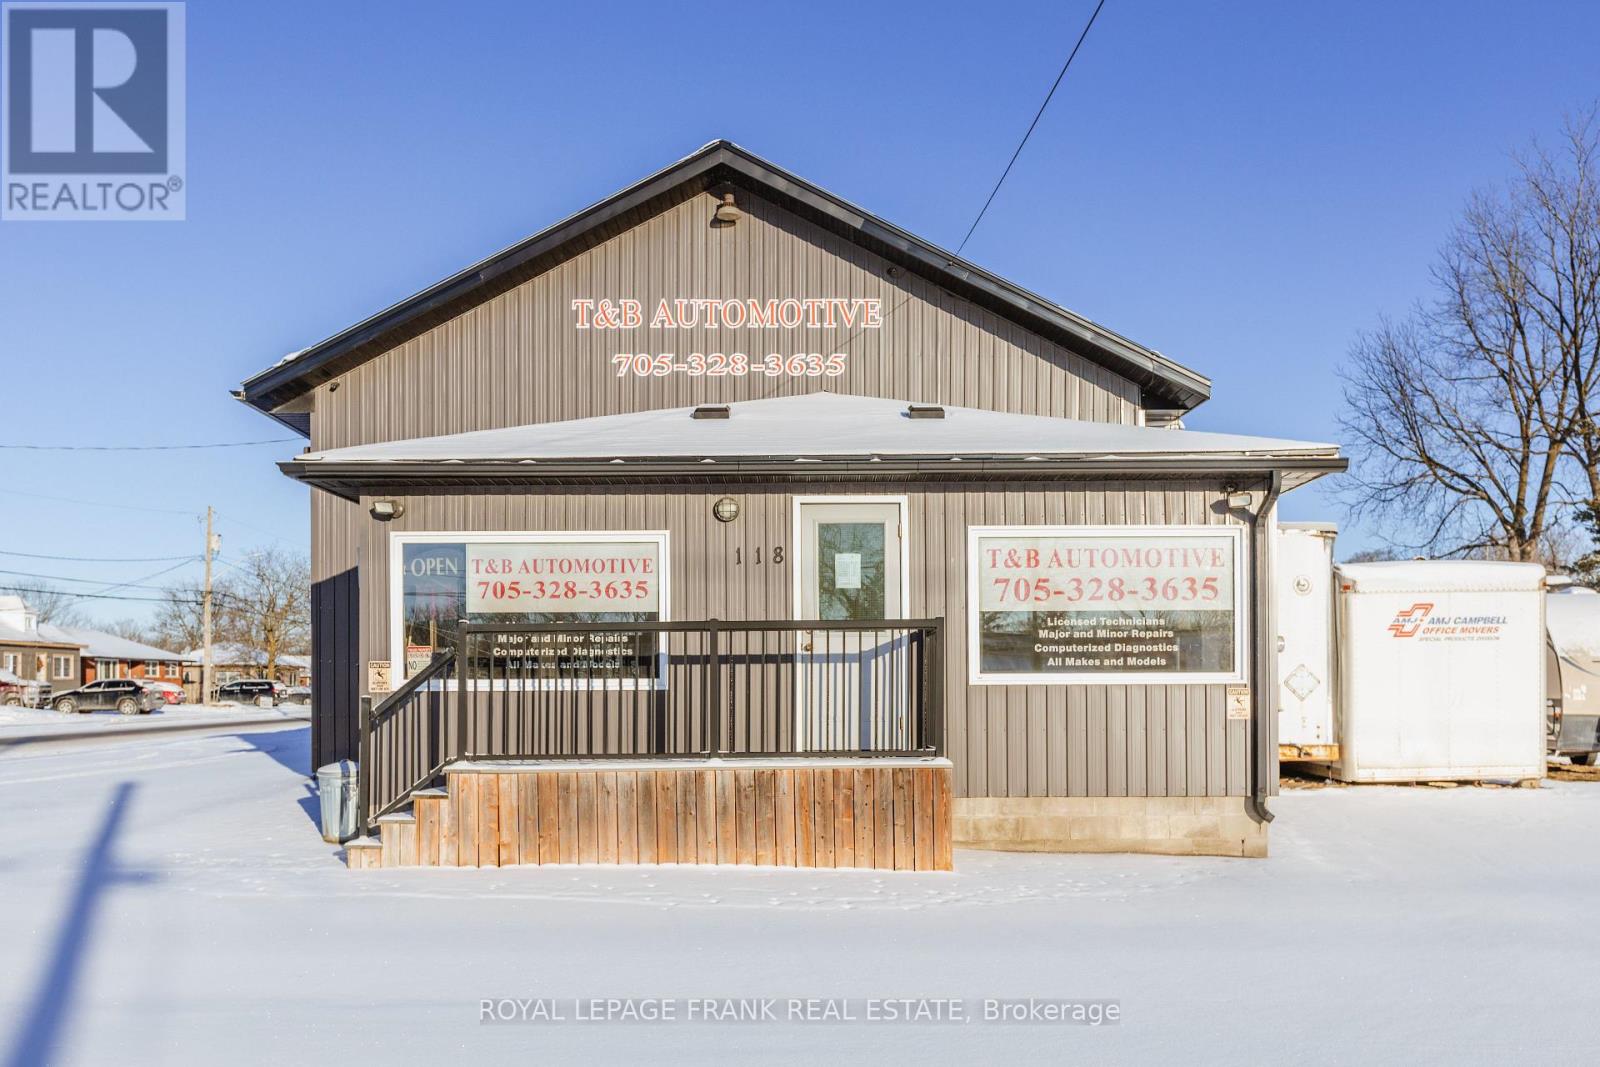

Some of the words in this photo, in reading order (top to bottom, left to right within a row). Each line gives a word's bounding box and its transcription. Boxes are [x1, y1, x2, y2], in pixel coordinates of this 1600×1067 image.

[571, 298, 642, 329] T&B
[650, 298, 883, 329] AUTOMOTIVE
[612, 353, 847, 377] 705-328-3635
[735, 546, 784, 565] 118
[986, 548, 1040, 569] T&B
[1048, 547, 1226, 569] AUTOMOTIVE
[411, 557, 458, 577] OPEN
[472, 558, 513, 574] T&B
[518, 558, 653, 574] AUTOMOTIVE
[477, 581, 649, 600] 705-328-3635
[993, 576, 1219, 602] 705-328-3635
[1047, 617, 1097, 626] Licensed
[1100, 617, 1166, 626] Technicians
[1428, 616, 1451, 625] AMJ
[1453, 616, 1508, 625] CAMPBELL
[1038, 629, 1071, 640] Major
[1073, 629, 1094, 638] and
[1096, 629, 1129, 638] Minor
[1131, 629, 1174, 640] Repairs
[1422, 626, 1457, 635] OFFICE
[1459, 626, 1500, 634] MOVERS
[1034, 643, 1111, 654] Computerized
[1114, 643, 1179, 654] Diagnostics
[1047, 657, 1062, 666] All
[1065, 657, 1100, 666] Makes
[1103, 657, 1124, 666] and
[1127, 657, 1167, 666] Models
